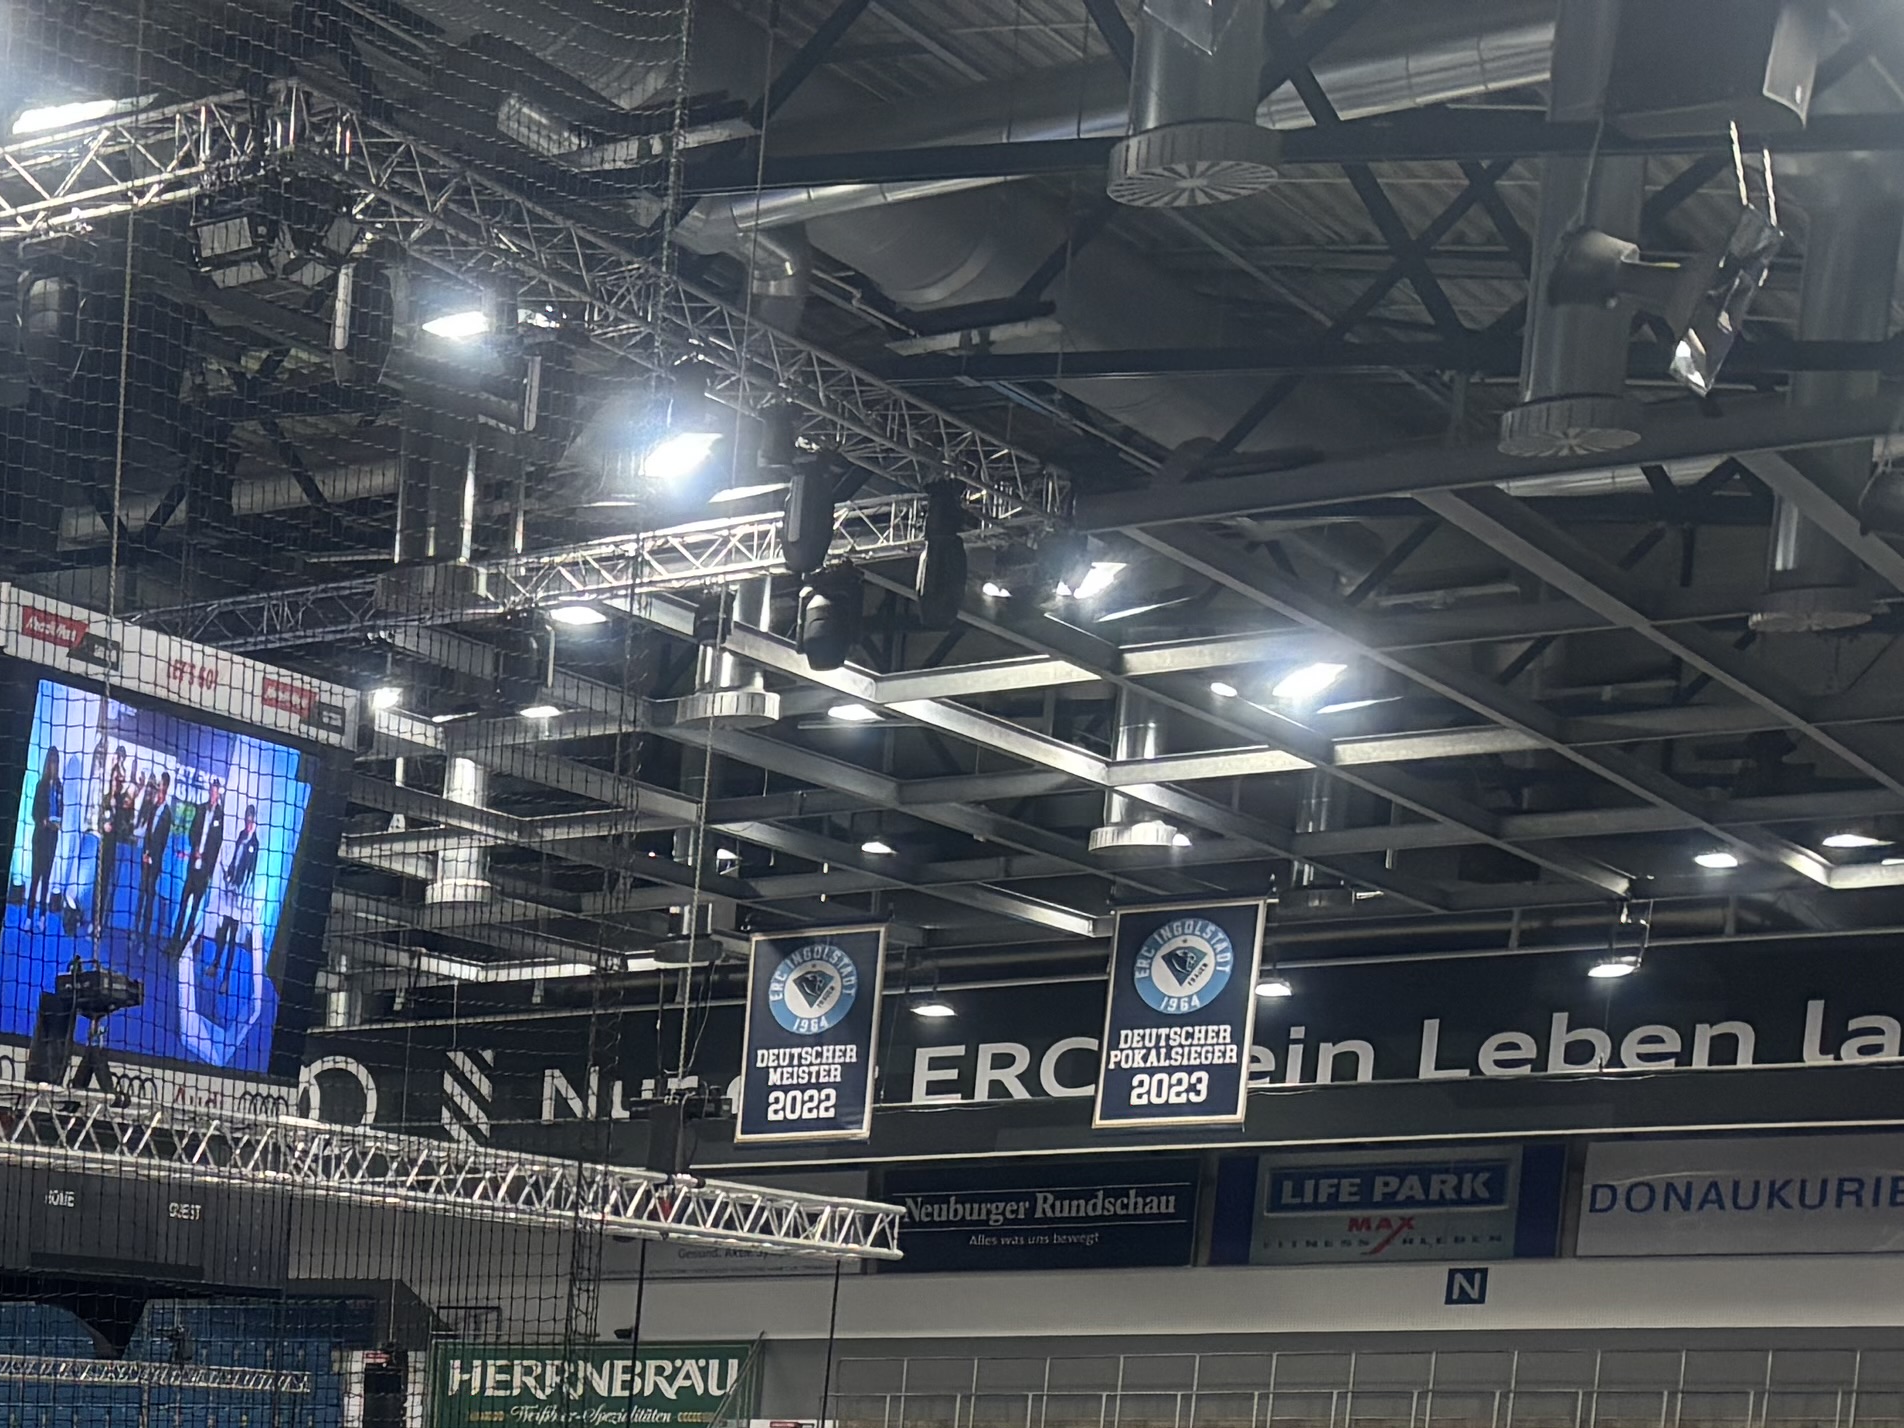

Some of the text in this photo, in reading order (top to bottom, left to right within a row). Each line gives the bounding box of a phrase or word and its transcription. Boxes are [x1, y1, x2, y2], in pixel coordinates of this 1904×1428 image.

[793, 1016, 829, 1033] 1964
[1118, 1025, 1231, 1049] DEUTSCHER
[756, 1044, 858, 1068] DEUTSCHER
[910, 1037, 1098, 1105] ERC
[1417, 1010, 1756, 1081] Leben
[1107, 1046, 1238, 1069] POKALSIEGER
[766, 1064, 842, 1085] MEISTER
[1131, 1071, 1209, 1106] 2023
[766, 1087, 837, 1122] 2022
[1282, 1171, 1492, 1205] LIFE PARK
[449, 1358, 739, 1400] HERRNBRÄU
